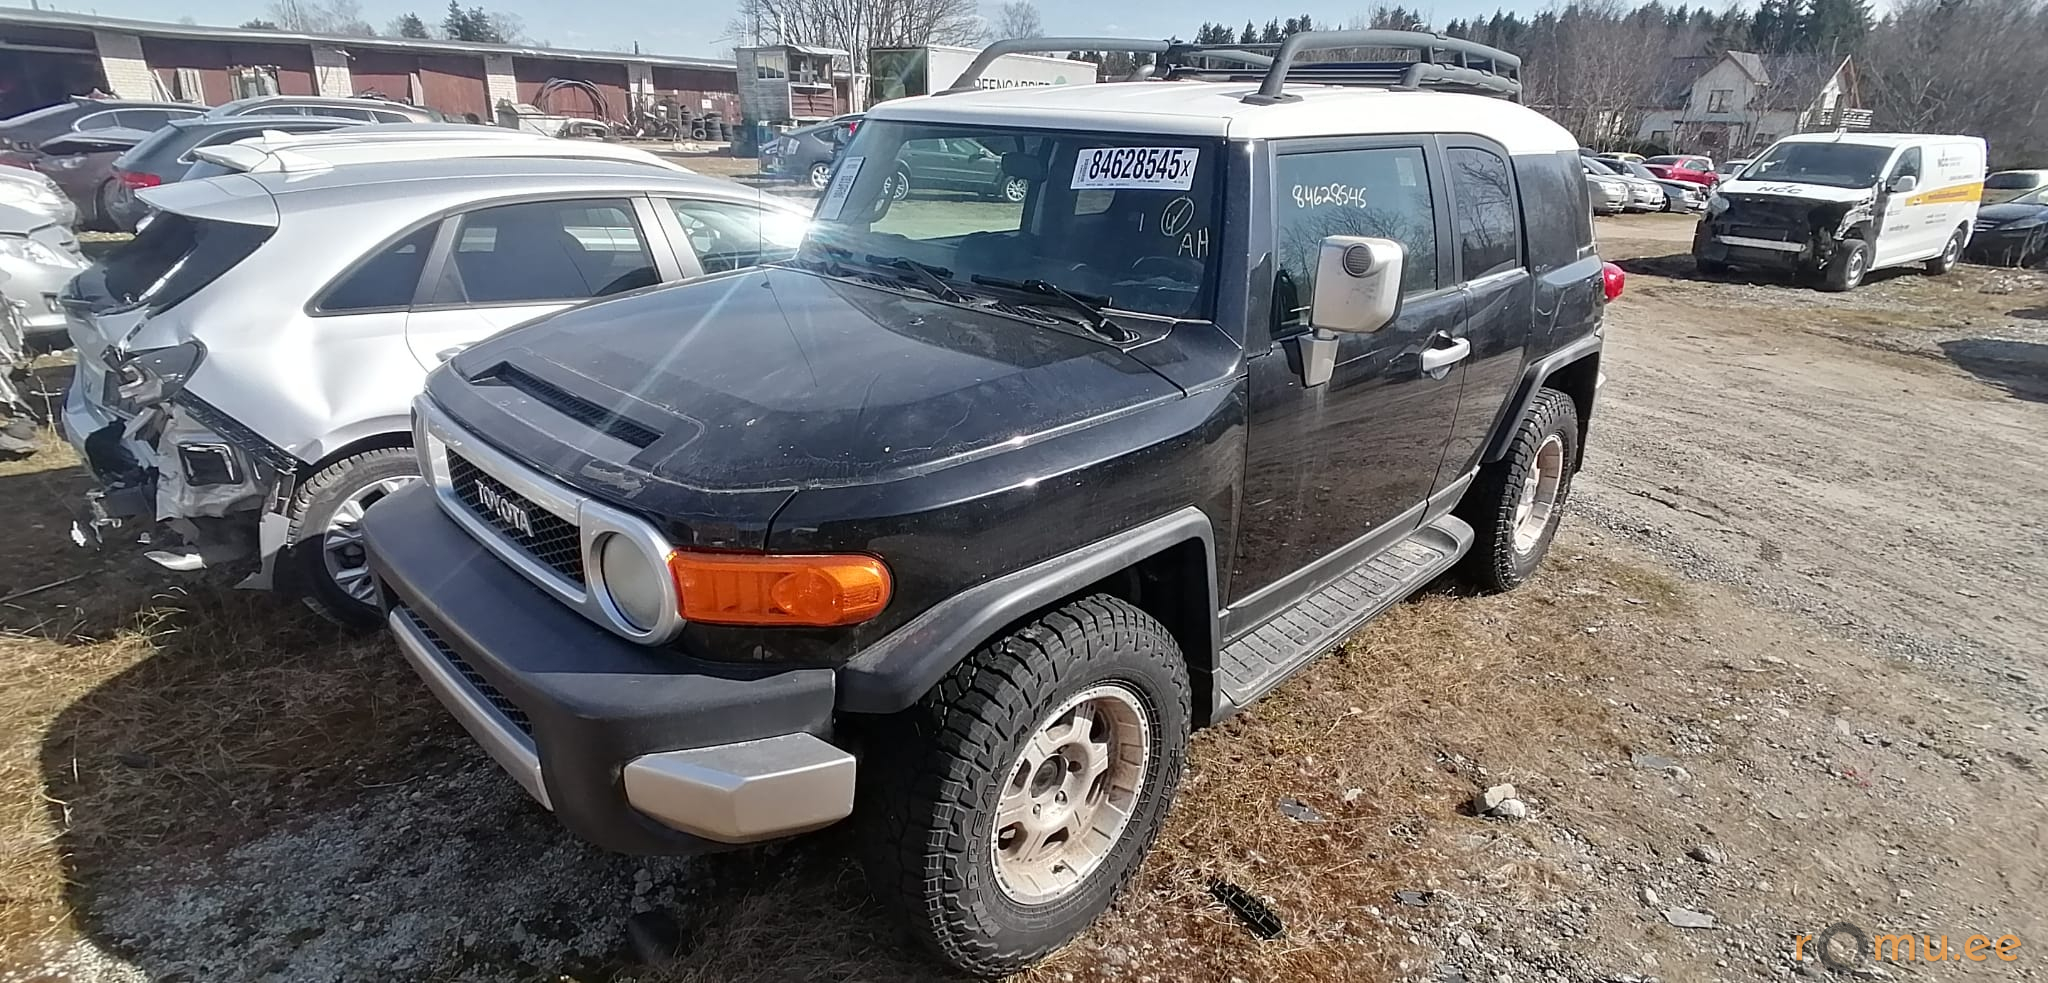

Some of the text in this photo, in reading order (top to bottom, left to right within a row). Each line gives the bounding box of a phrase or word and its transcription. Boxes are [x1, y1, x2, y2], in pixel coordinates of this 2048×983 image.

[1292, 183, 1367, 209] 84628545
[1757, 186, 1803, 194] NCC
[475, 479, 534, 538] TOYOTA
